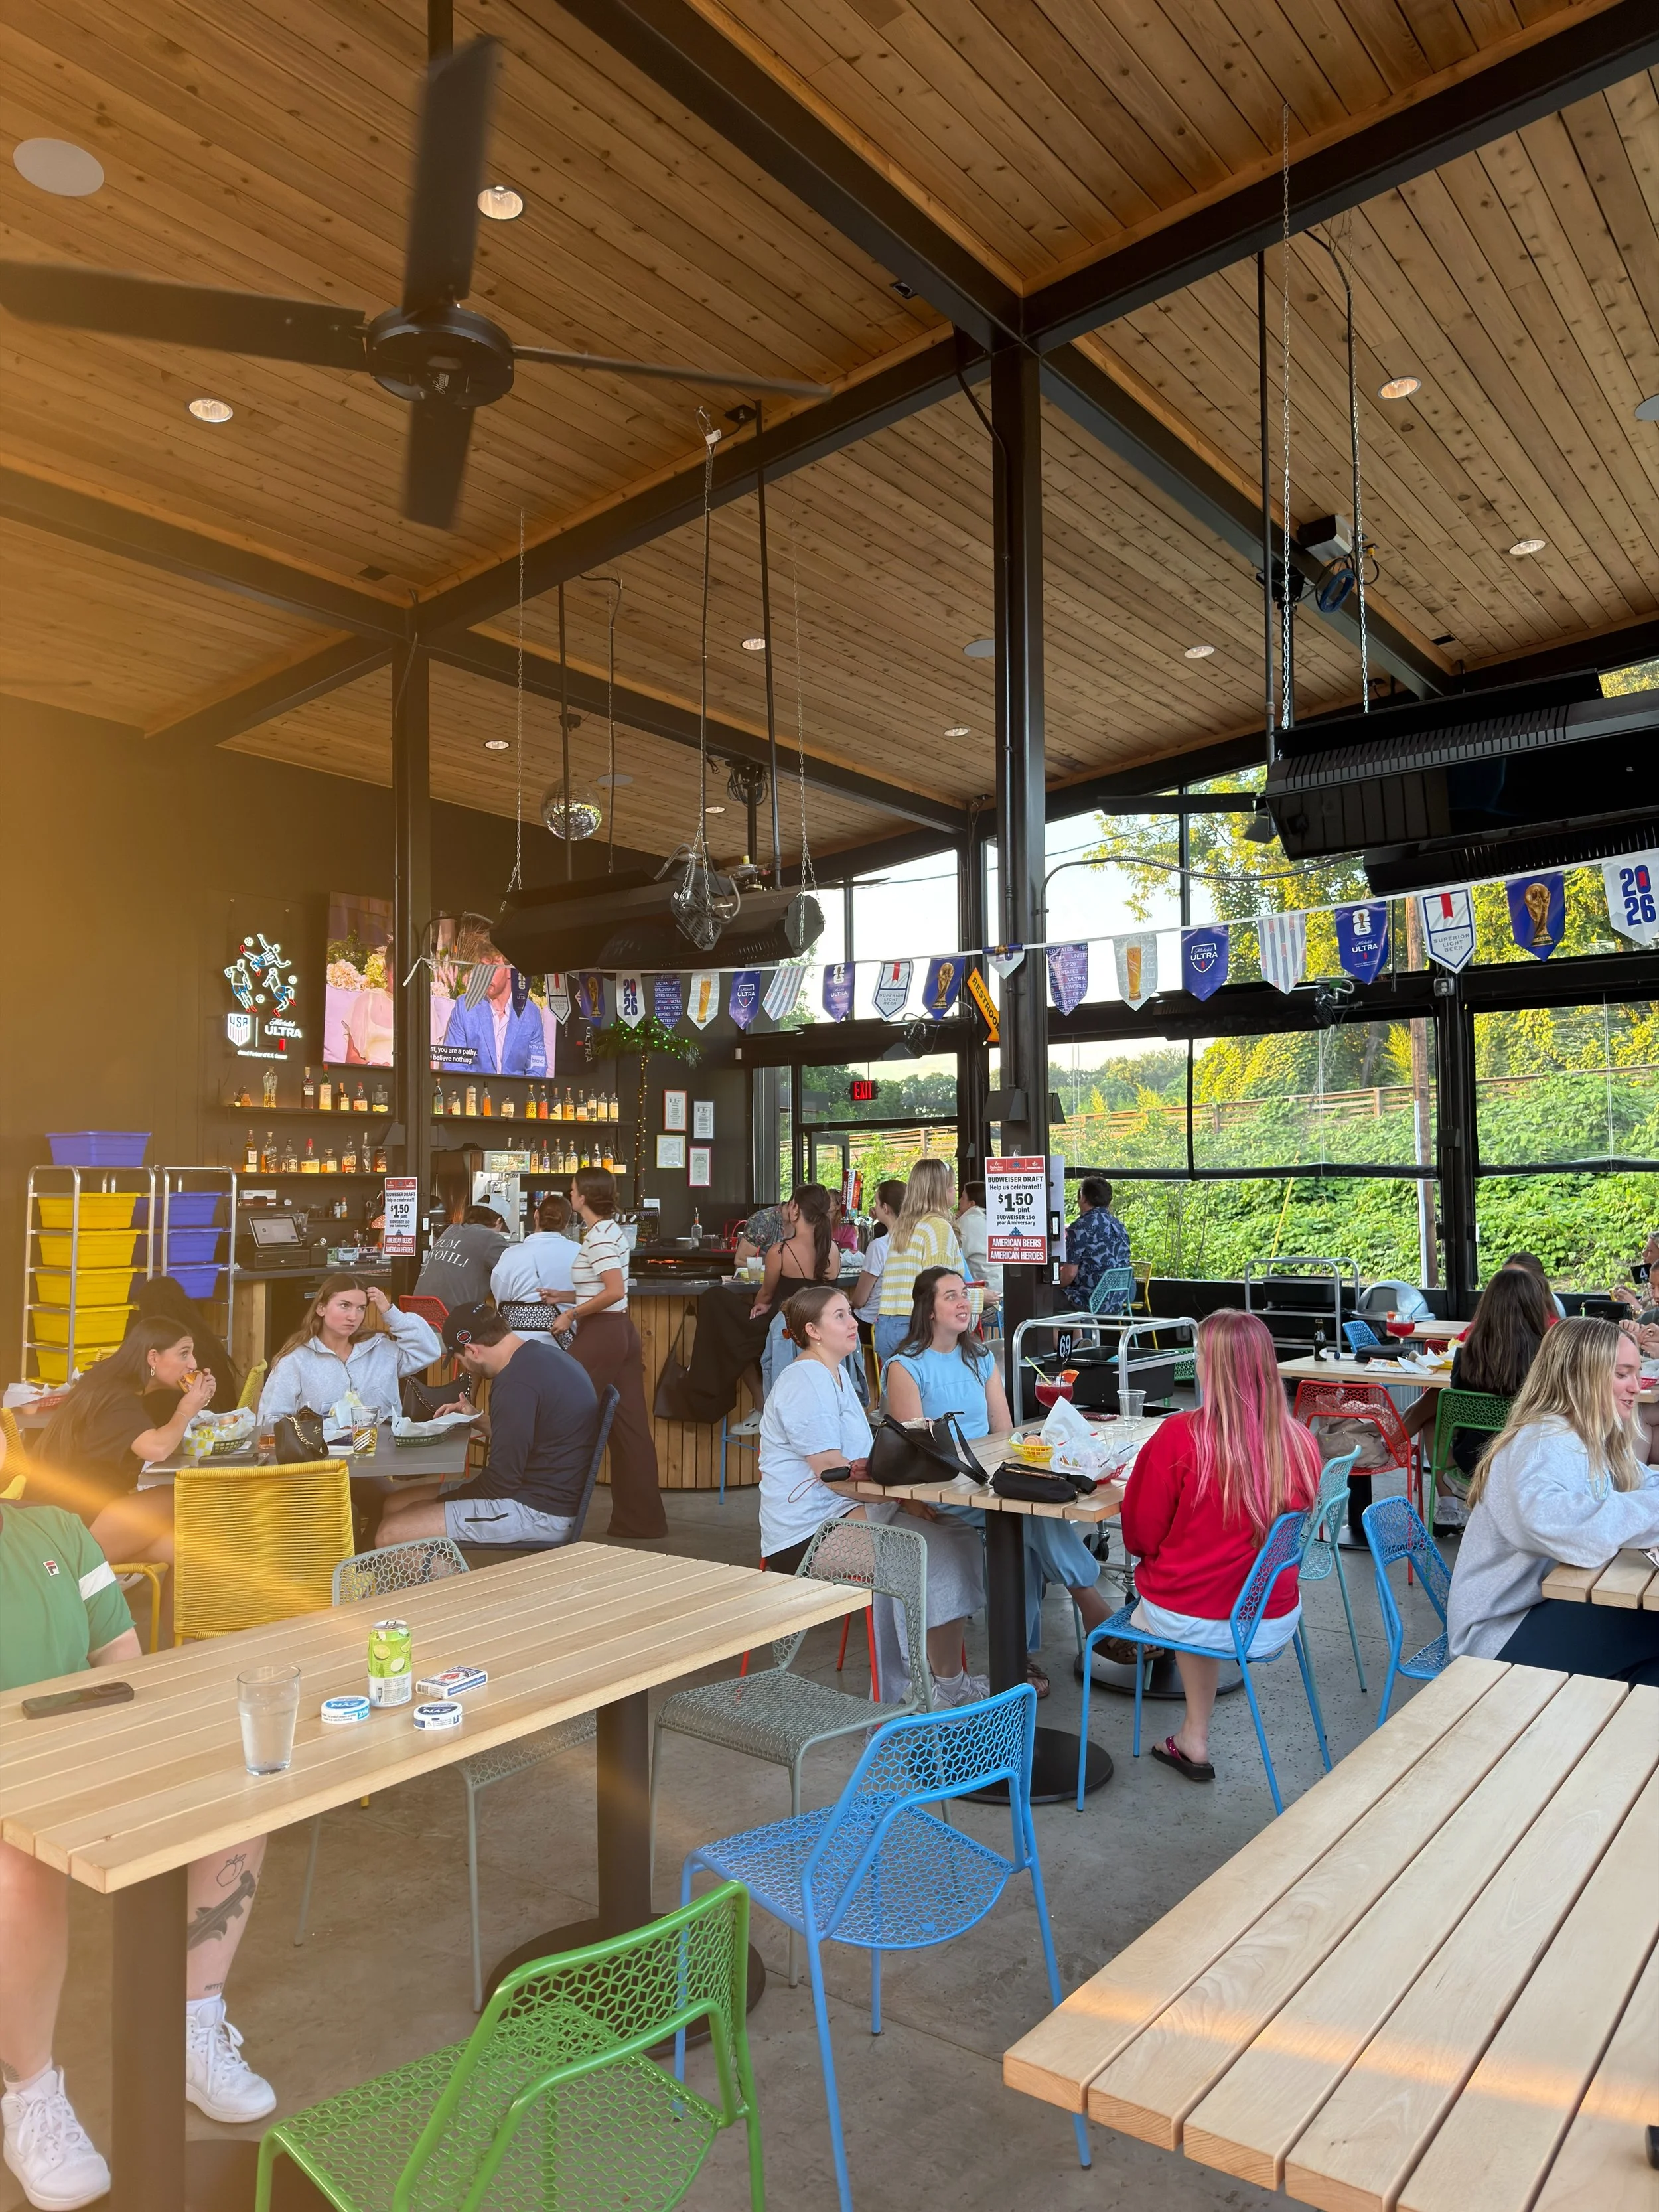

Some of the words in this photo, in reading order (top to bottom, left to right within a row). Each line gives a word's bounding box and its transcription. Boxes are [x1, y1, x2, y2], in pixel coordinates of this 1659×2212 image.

[1624, 894, 1656, 926] 26
[1433, 933, 1470, 944] SUPERIOR
[1352, 943, 1378, 953] ULTRA
[1190, 952, 1218, 961] ULTRA
[624, 997, 638, 1015] 26
[230, 1016, 248, 1027] USA
[265, 1025, 303, 1038] ULTRA
[453, 1056, 473, 1065] nothing.
[854, 1081, 872, 1099] EXIT
[998, 1193, 1033, 1212] $1.50
[390, 1204, 409, 1218] $1.50
[992, 1238, 1021, 1247] AMERICAN
[1022, 1238, 1041, 1248] BEERS
[990, 1251, 1021, 1260] AMERICAN
[1021, 1251, 1044, 1260] HEROES
[1060, 1335, 1071, 1357] 69
